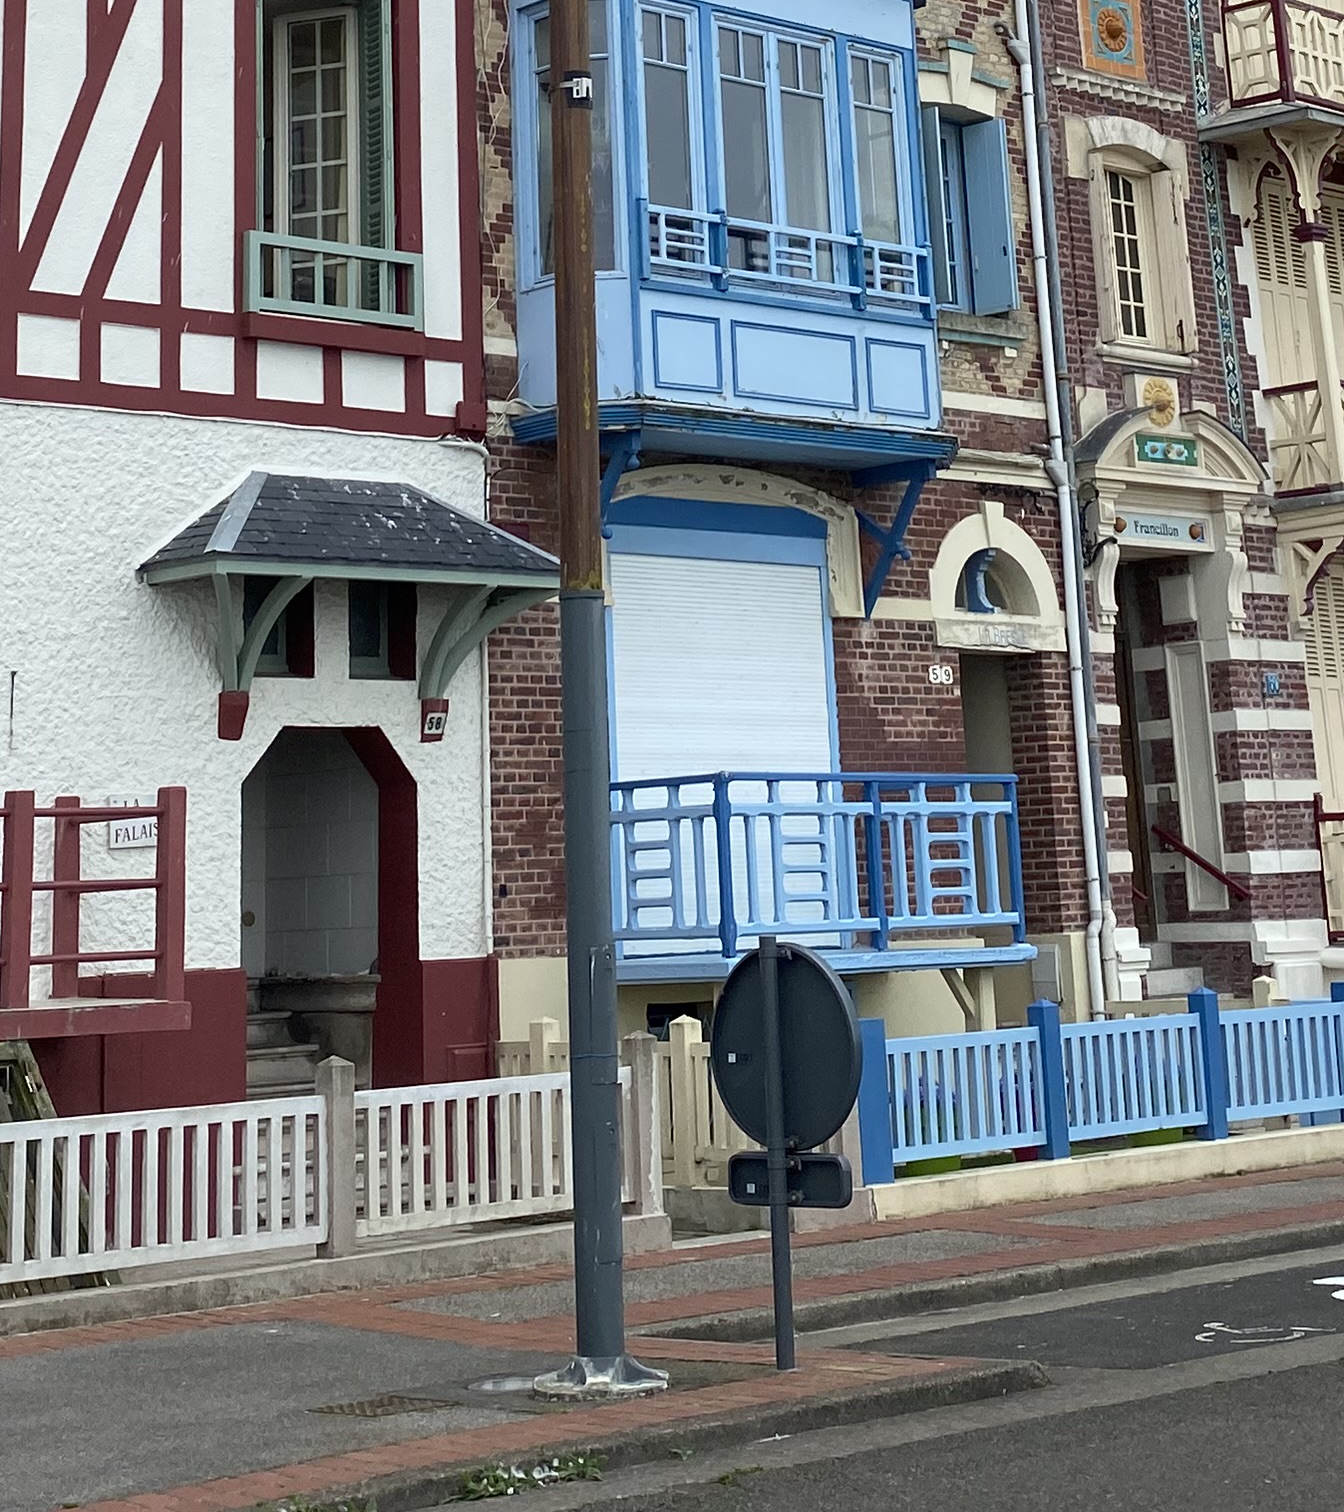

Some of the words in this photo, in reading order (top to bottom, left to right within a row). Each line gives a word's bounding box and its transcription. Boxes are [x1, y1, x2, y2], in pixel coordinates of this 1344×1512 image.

[1133, 520, 1179, 537] Francillon
[932, 668, 951, 682] 59
[427, 716, 443, 731] 58
